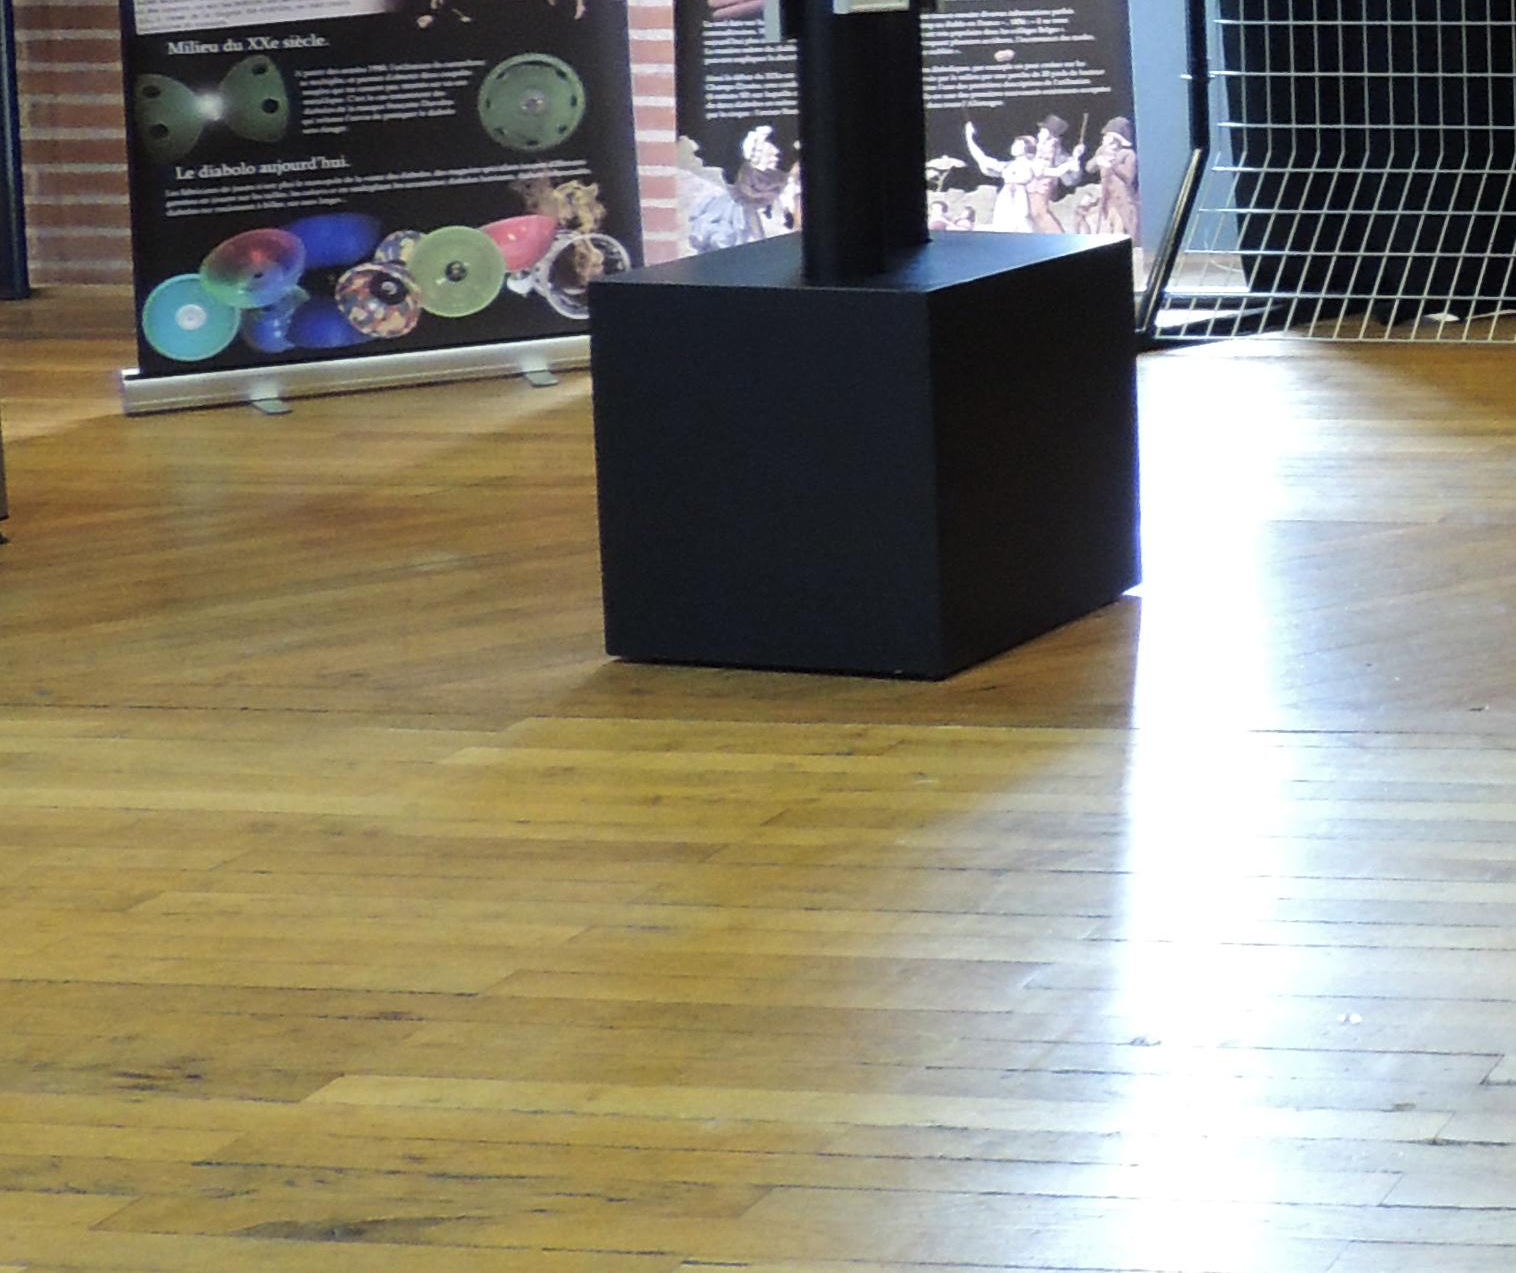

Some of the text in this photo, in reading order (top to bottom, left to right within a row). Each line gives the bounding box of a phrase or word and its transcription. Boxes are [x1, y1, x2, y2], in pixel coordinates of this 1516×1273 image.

[167, 39, 220, 56] Milieu
[222, 38, 245, 53] du
[281, 32, 331, 49] siècle.
[174, 165, 196, 181] Le
[197, 161, 256, 179] diabolo
